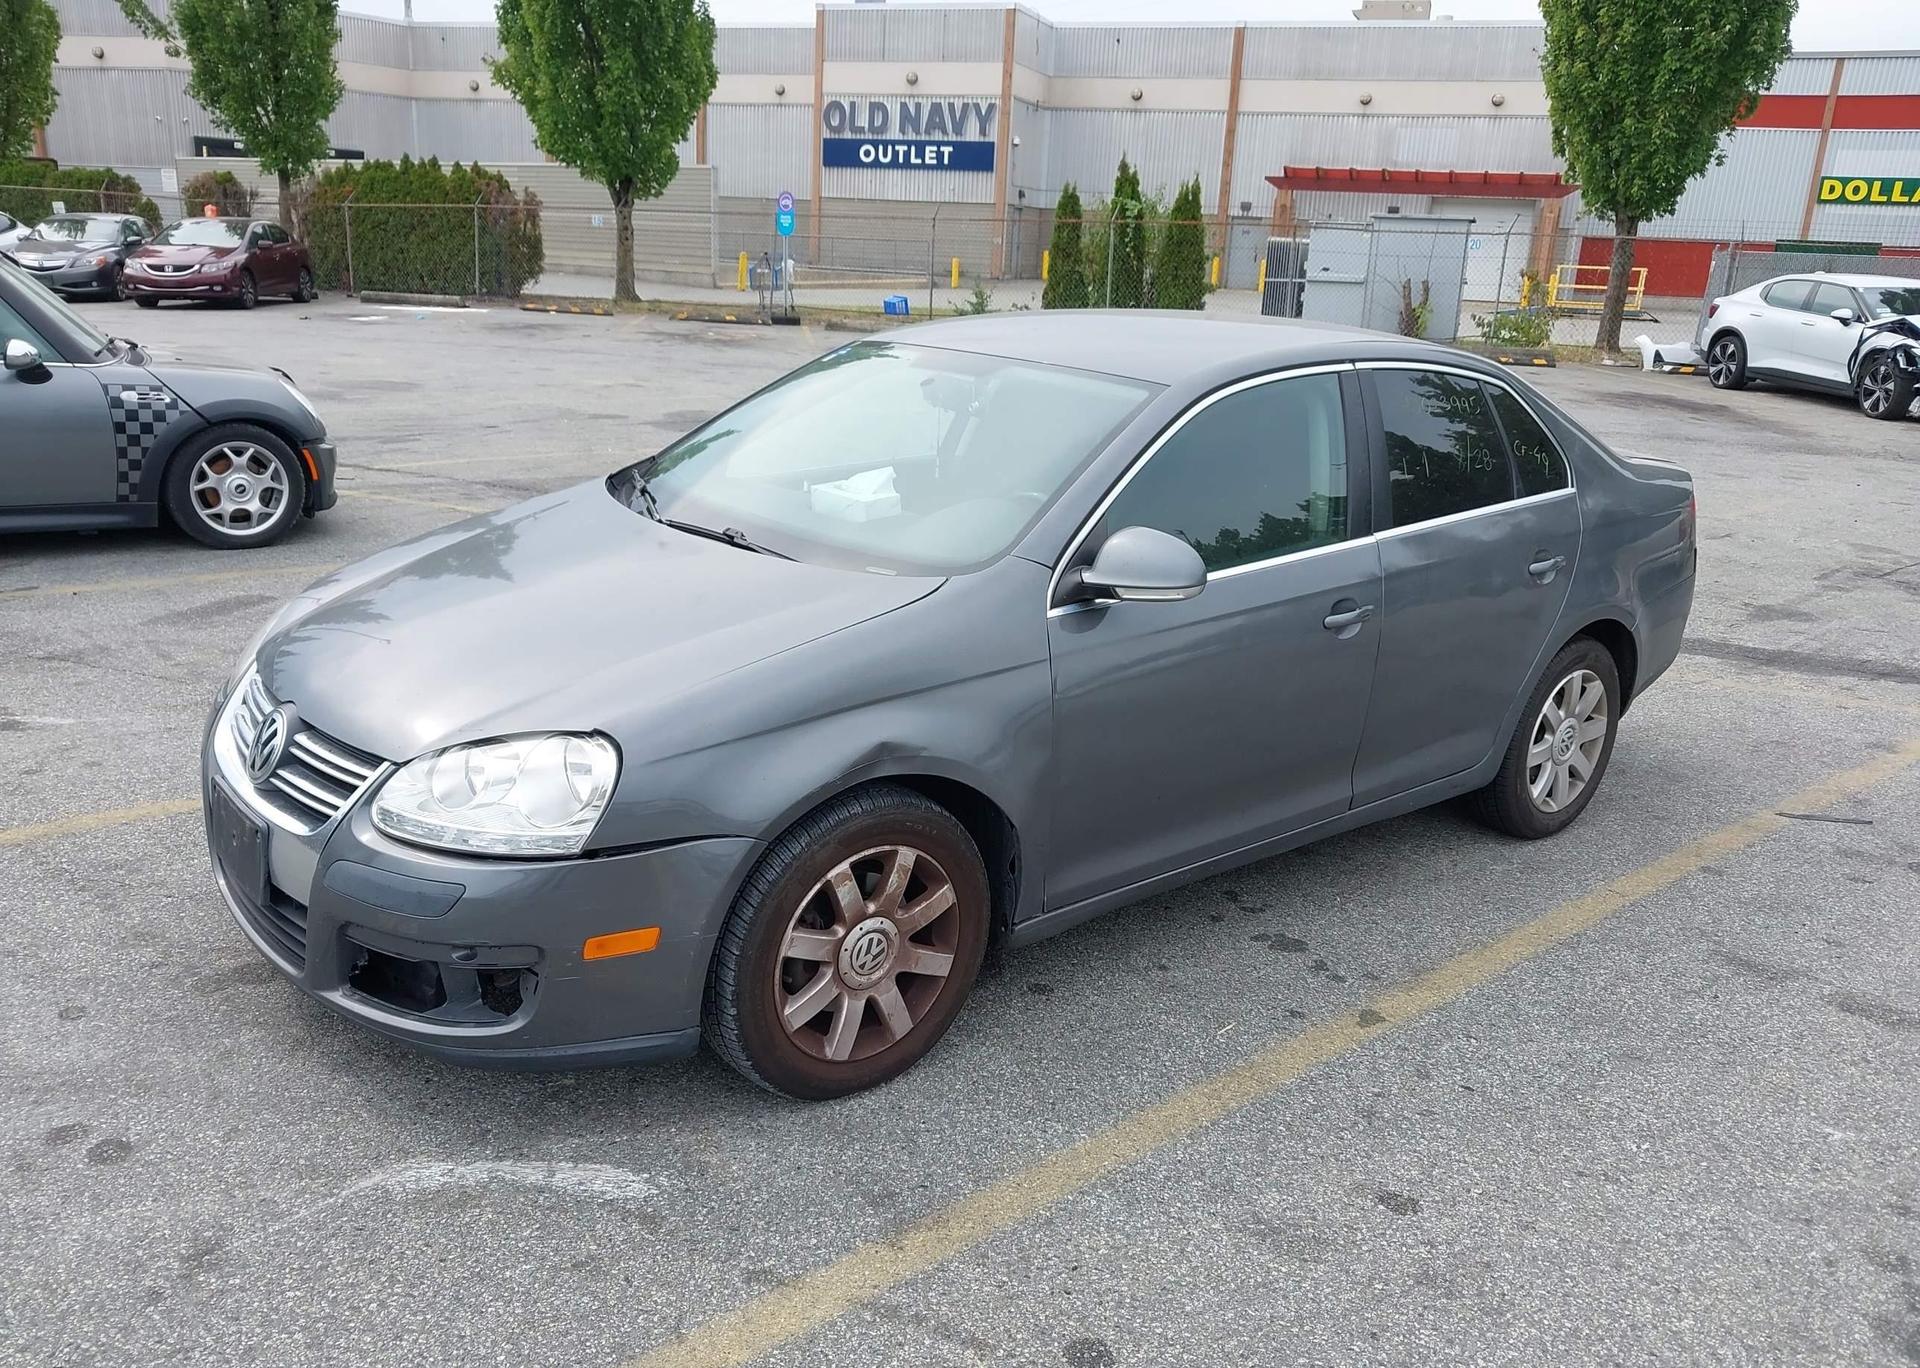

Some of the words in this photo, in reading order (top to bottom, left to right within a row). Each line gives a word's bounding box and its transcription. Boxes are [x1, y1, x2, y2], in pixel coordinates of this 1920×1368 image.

[823, 100, 890, 135] OLD
[899, 101, 997, 137] NAVY
[859, 144, 953, 165] OUTLET
[1470, 239, 1481, 250] 20
